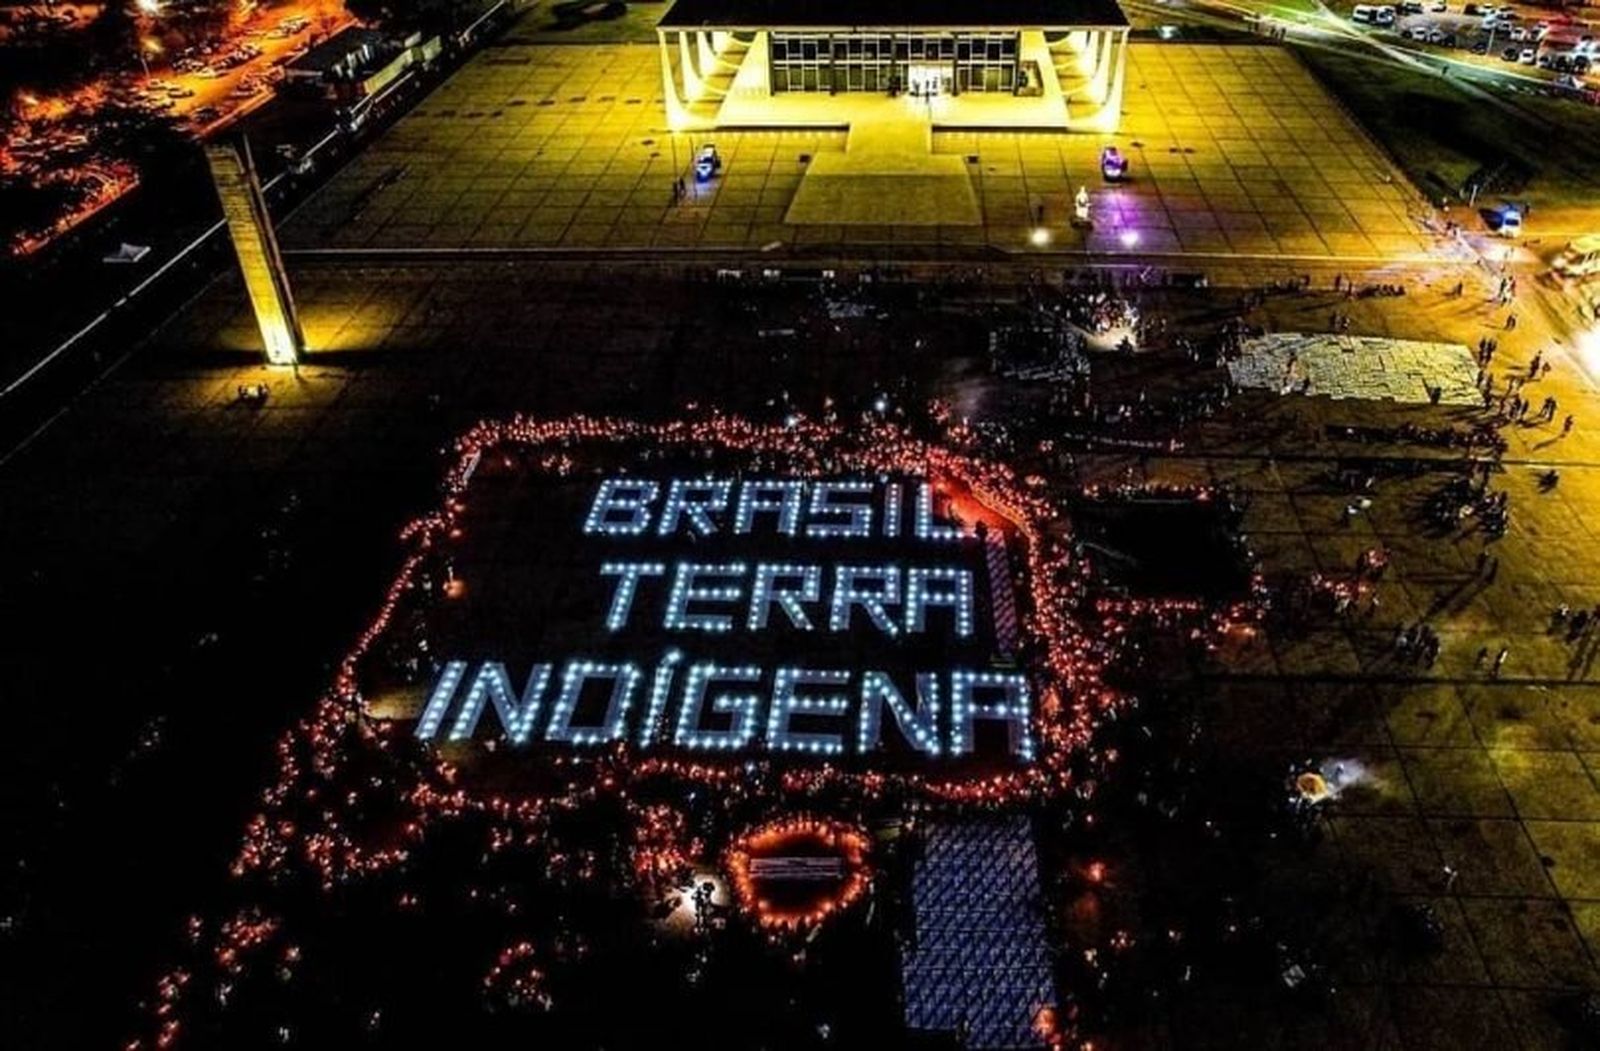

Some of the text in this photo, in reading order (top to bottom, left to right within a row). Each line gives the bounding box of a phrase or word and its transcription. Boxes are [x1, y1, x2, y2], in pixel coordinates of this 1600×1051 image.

[583, 478, 977, 538] BRASIL
[600, 563, 974, 636] TERRA
[414, 650, 1035, 760] INDÍGENA
